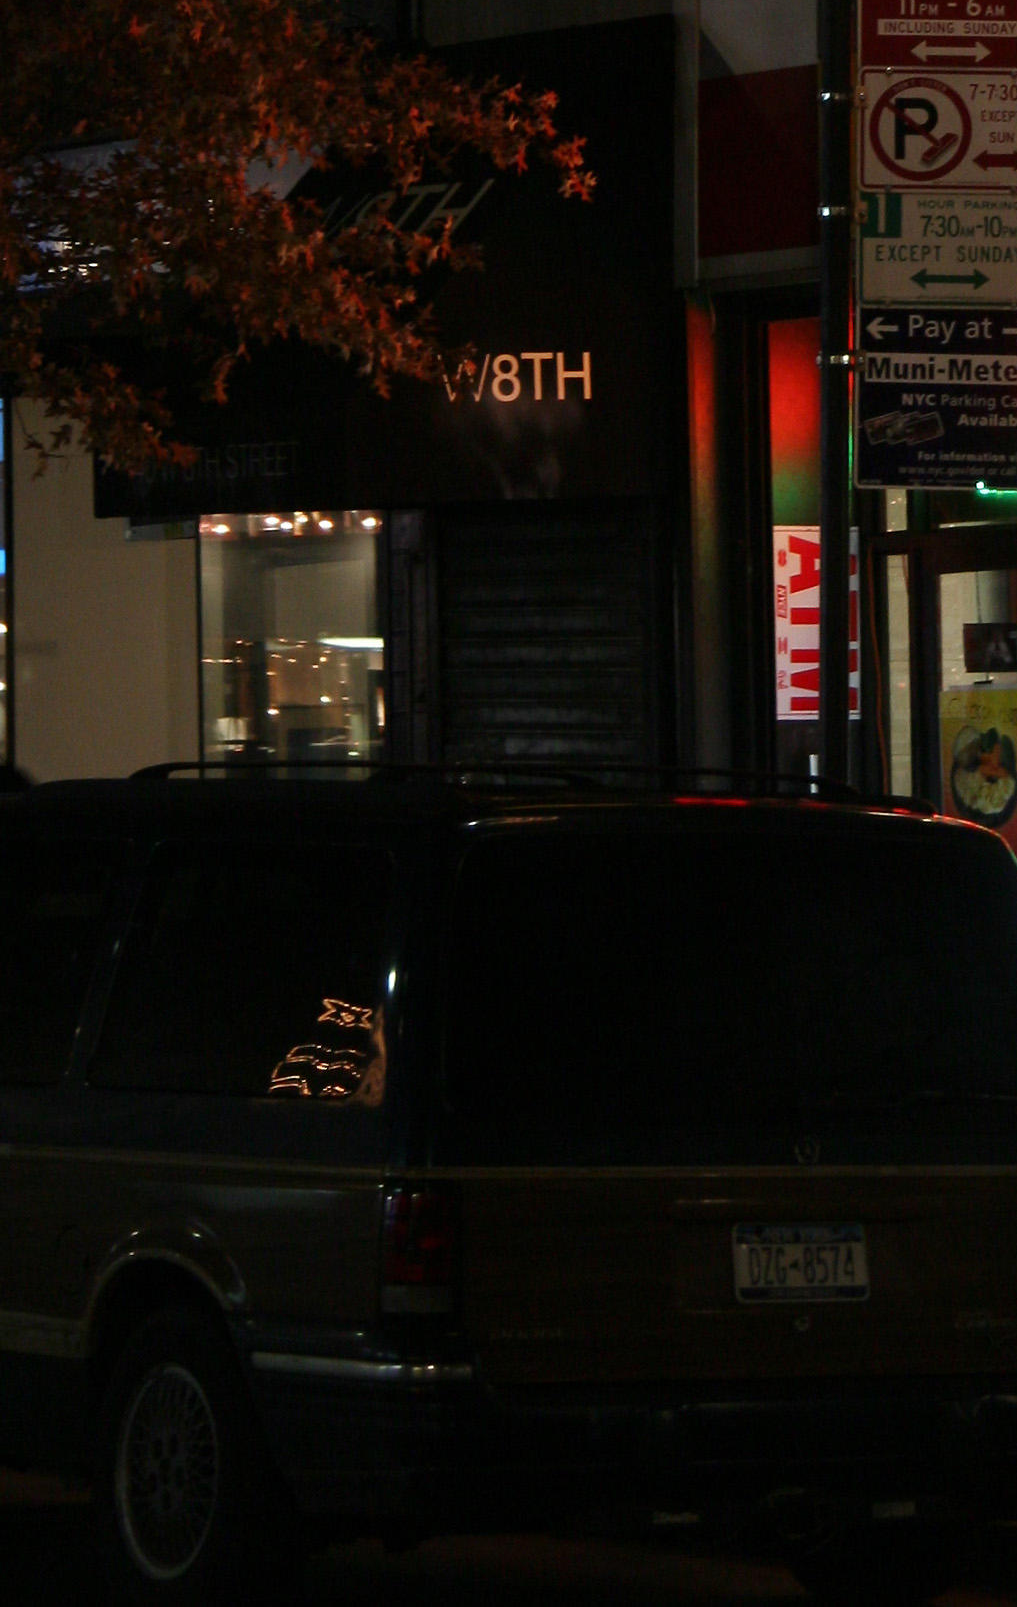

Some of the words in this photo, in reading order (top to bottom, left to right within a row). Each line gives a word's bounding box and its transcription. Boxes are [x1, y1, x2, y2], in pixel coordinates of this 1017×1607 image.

[884, 22, 955, 35] INCLUDING
[964, 23, 1017, 36] SUNDAY
[989, 131, 1015, 144] SUN
[918, 200, 954, 210] HOUR
[875, 245, 941, 262] EXCEPT
[907, 314, 955, 344] Pay
[964, 317, 993, 339] at
[902, 393, 936, 406] NYC
[940, 394, 996, 410] Parking
